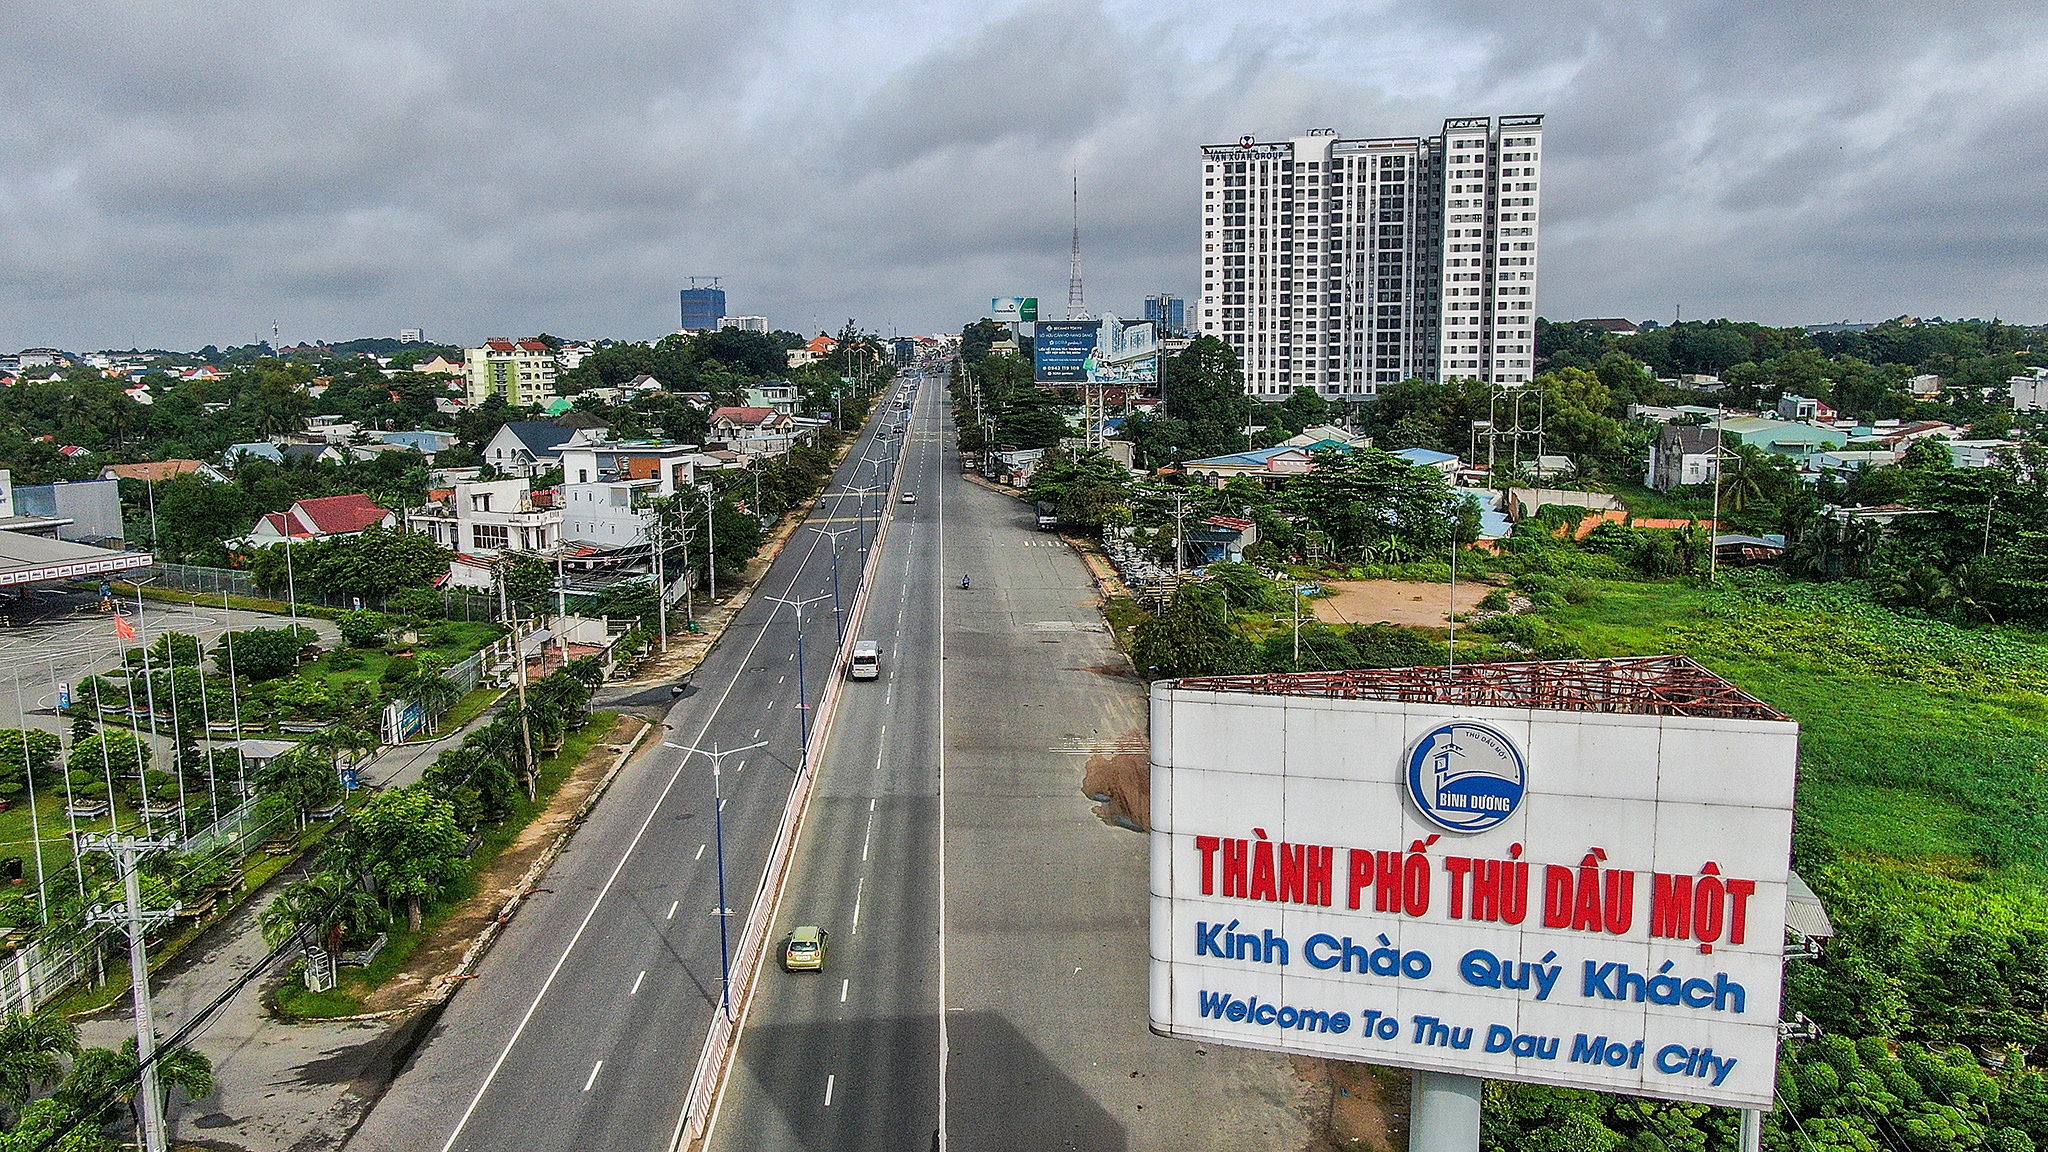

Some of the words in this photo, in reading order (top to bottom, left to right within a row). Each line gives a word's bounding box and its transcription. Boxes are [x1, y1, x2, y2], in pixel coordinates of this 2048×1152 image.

[1254, 152, 1284, 160] GROUP
[1439, 791, 1467, 808] BÌNH
[1471, 793, 1511, 812] DƯƠNG
[1196, 827, 1334, 907] THÀNH
[1348, 834, 1442, 918] PHỐ
[1445, 843, 1529, 925] THỦ
[1543, 847, 1635, 936] DẦU
[1650, 861, 1756, 955] MỘT
[1196, 919, 1290, 966] Kính
[1304, 932, 1433, 980] Chào
[1459, 949, 1563, 1002] Quý
[1583, 960, 1747, 1013] Khách
[1199, 989, 1351, 1034] Welcome
[1363, 1009, 1399, 1041] To
[1413, 1015, 1474, 1051] Thu
[1484, 1023, 1561, 1061] Dau
[1570, 1033, 1645, 1070] Mot
[1655, 1043, 1739, 1088] City
